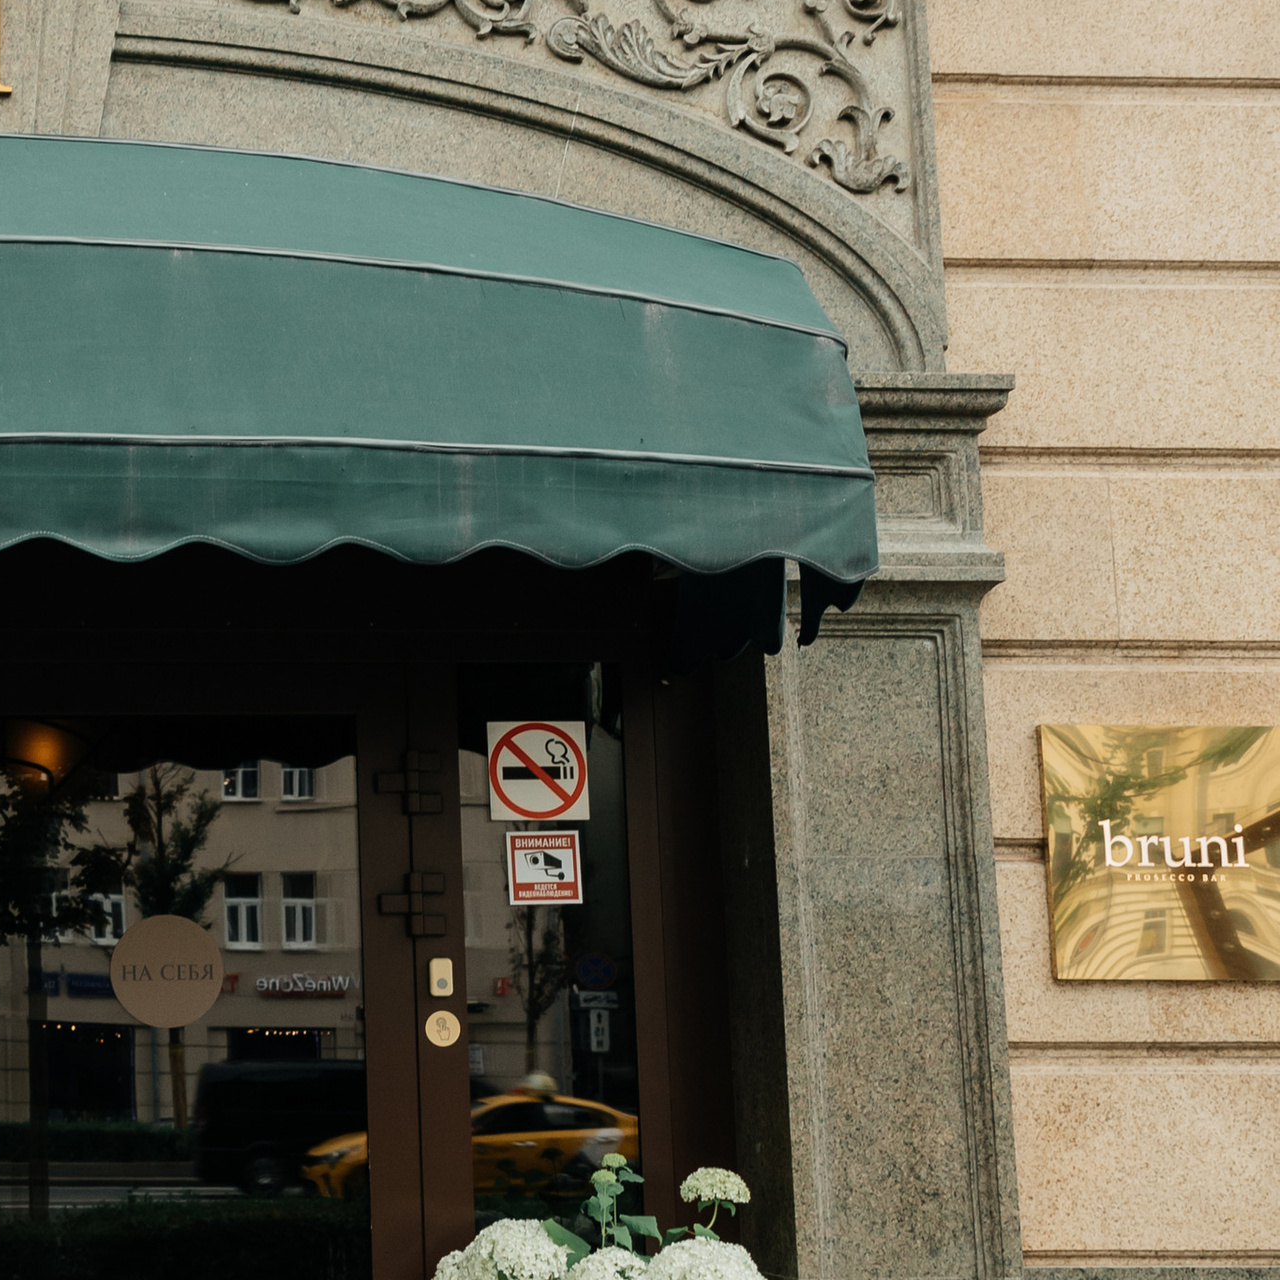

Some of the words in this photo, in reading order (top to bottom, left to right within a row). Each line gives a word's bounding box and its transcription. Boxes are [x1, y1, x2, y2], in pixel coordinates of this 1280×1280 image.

[515, 837, 571, 848] ВНИМАНИЕ!
[1098, 819, 1250, 868] bruni
[1126, 873, 1195, 883] PROSECCO
[1202, 873, 1227, 883] BAR
[122, 964, 153, 982] НА
[160, 964, 214, 981] СЕБЯ
